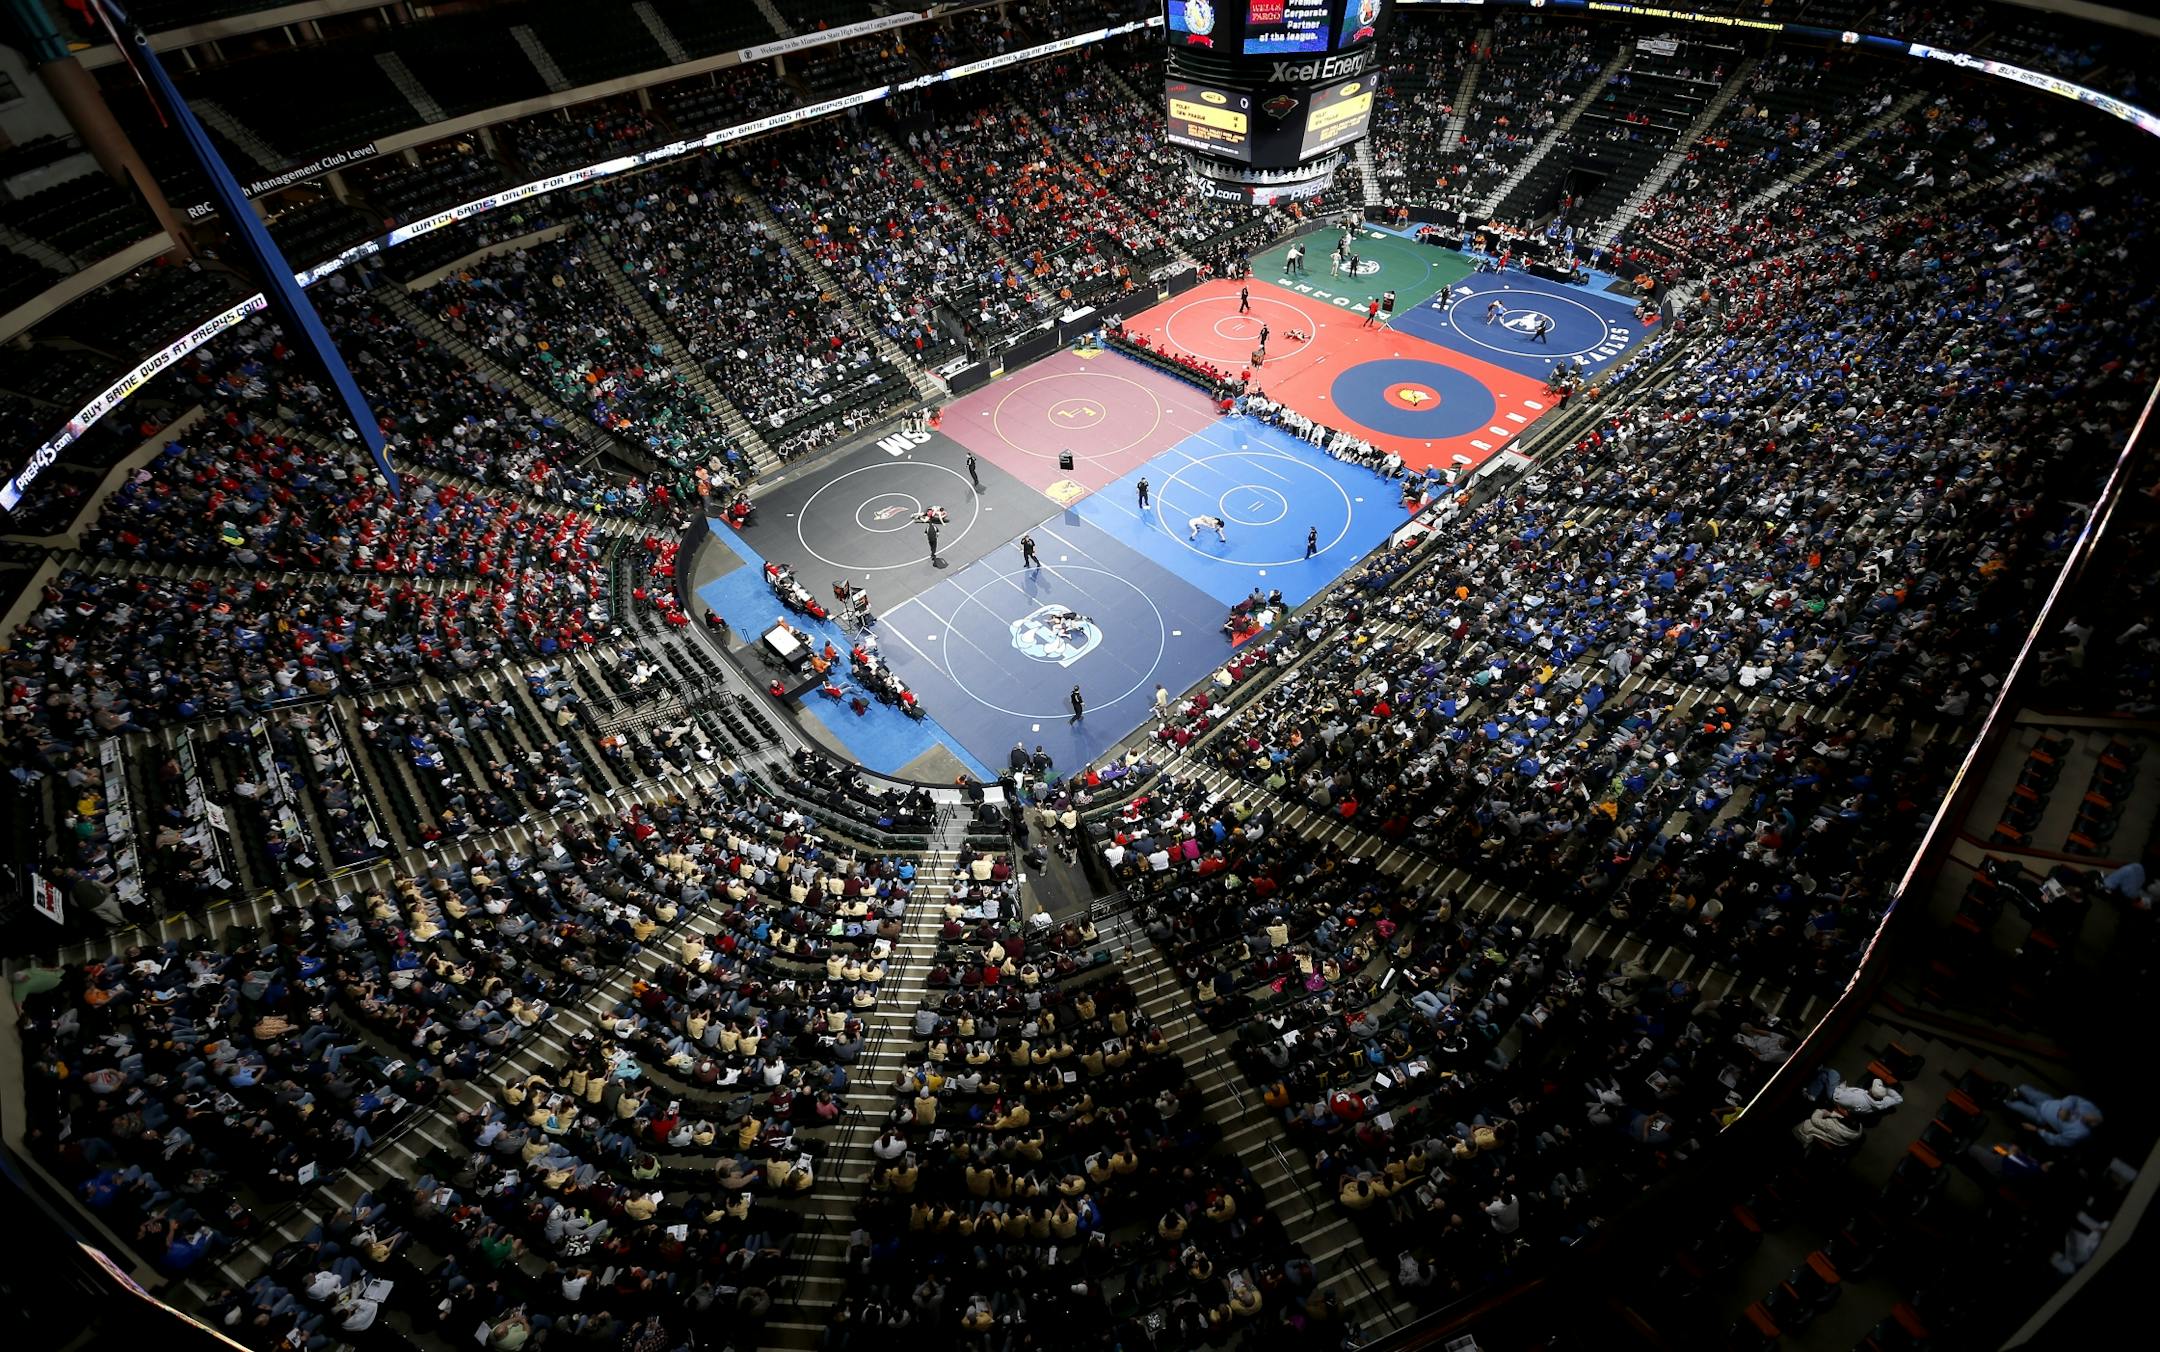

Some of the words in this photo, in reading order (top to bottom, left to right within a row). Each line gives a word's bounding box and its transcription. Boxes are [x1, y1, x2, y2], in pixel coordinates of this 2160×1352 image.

[1284, 8, 1328, 18] Corporate
[1287, 20, 1321, 29] Partner
[1632, 6, 1644, 15] the
[1694, 13, 1733, 25] Wrestling
[1734, 18, 1784, 30] Tournament
[1259, 33, 1269, 41] of
[1270, 32, 1285, 41] the
[1268, 60, 1321, 82] Xcel
[1321, 56, 1366, 77] Energy
[187, 201, 215, 219] RBC
[251, 161, 323, 195] Management
[322, 153, 347, 169] Club
[347, 143, 377, 160] Level
[411, 213, 453, 234] WATCH
[457, 198, 497, 217] GAMES
[501, 184, 539, 202] ONLINE
[542, 177, 565, 189] FOR
[569, 168, 597, 181] FREE
[1572, 327, 1630, 366] EAGLES
[81, 402, 102, 424] BUY
[105, 374, 139, 403] GAME
[172, 339, 188, 356] AT
[1452, 399, 1544, 465] ORONO
